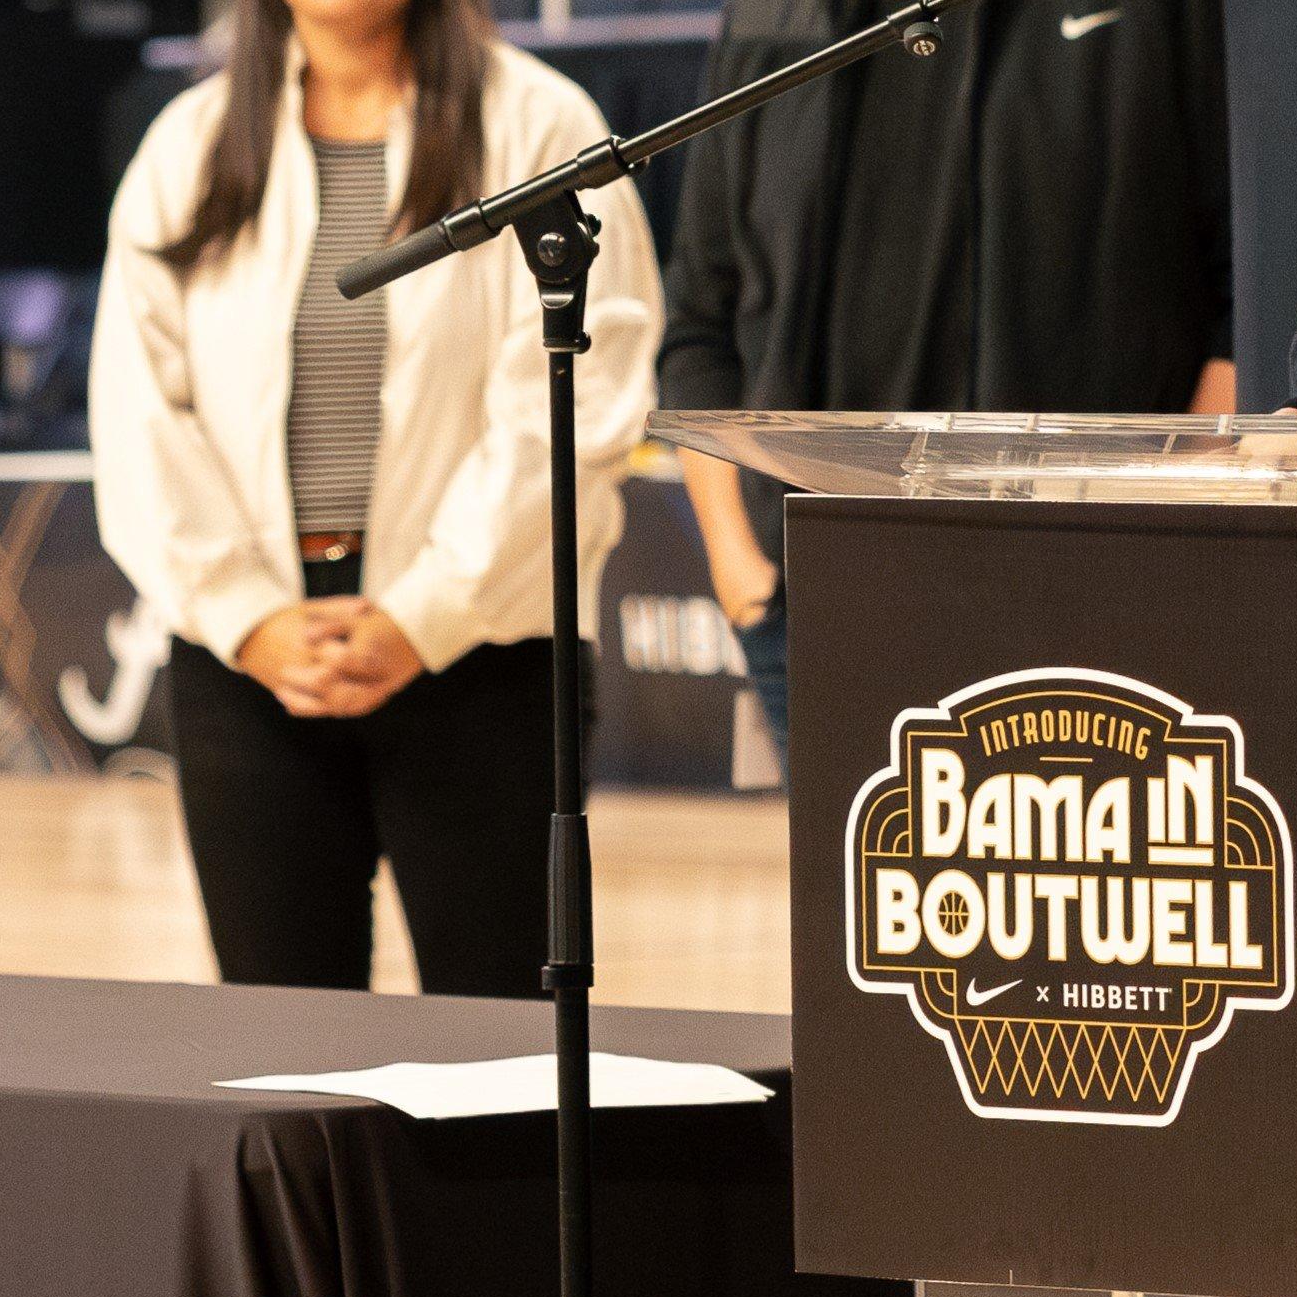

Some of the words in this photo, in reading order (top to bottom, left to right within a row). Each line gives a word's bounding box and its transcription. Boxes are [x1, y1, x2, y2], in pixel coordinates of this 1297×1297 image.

[980, 709, 1152, 761] INTRODUCING
[876, 868, 1264, 970] BOUTWELL
[1062, 983, 1170, 1012] HIBBETT
